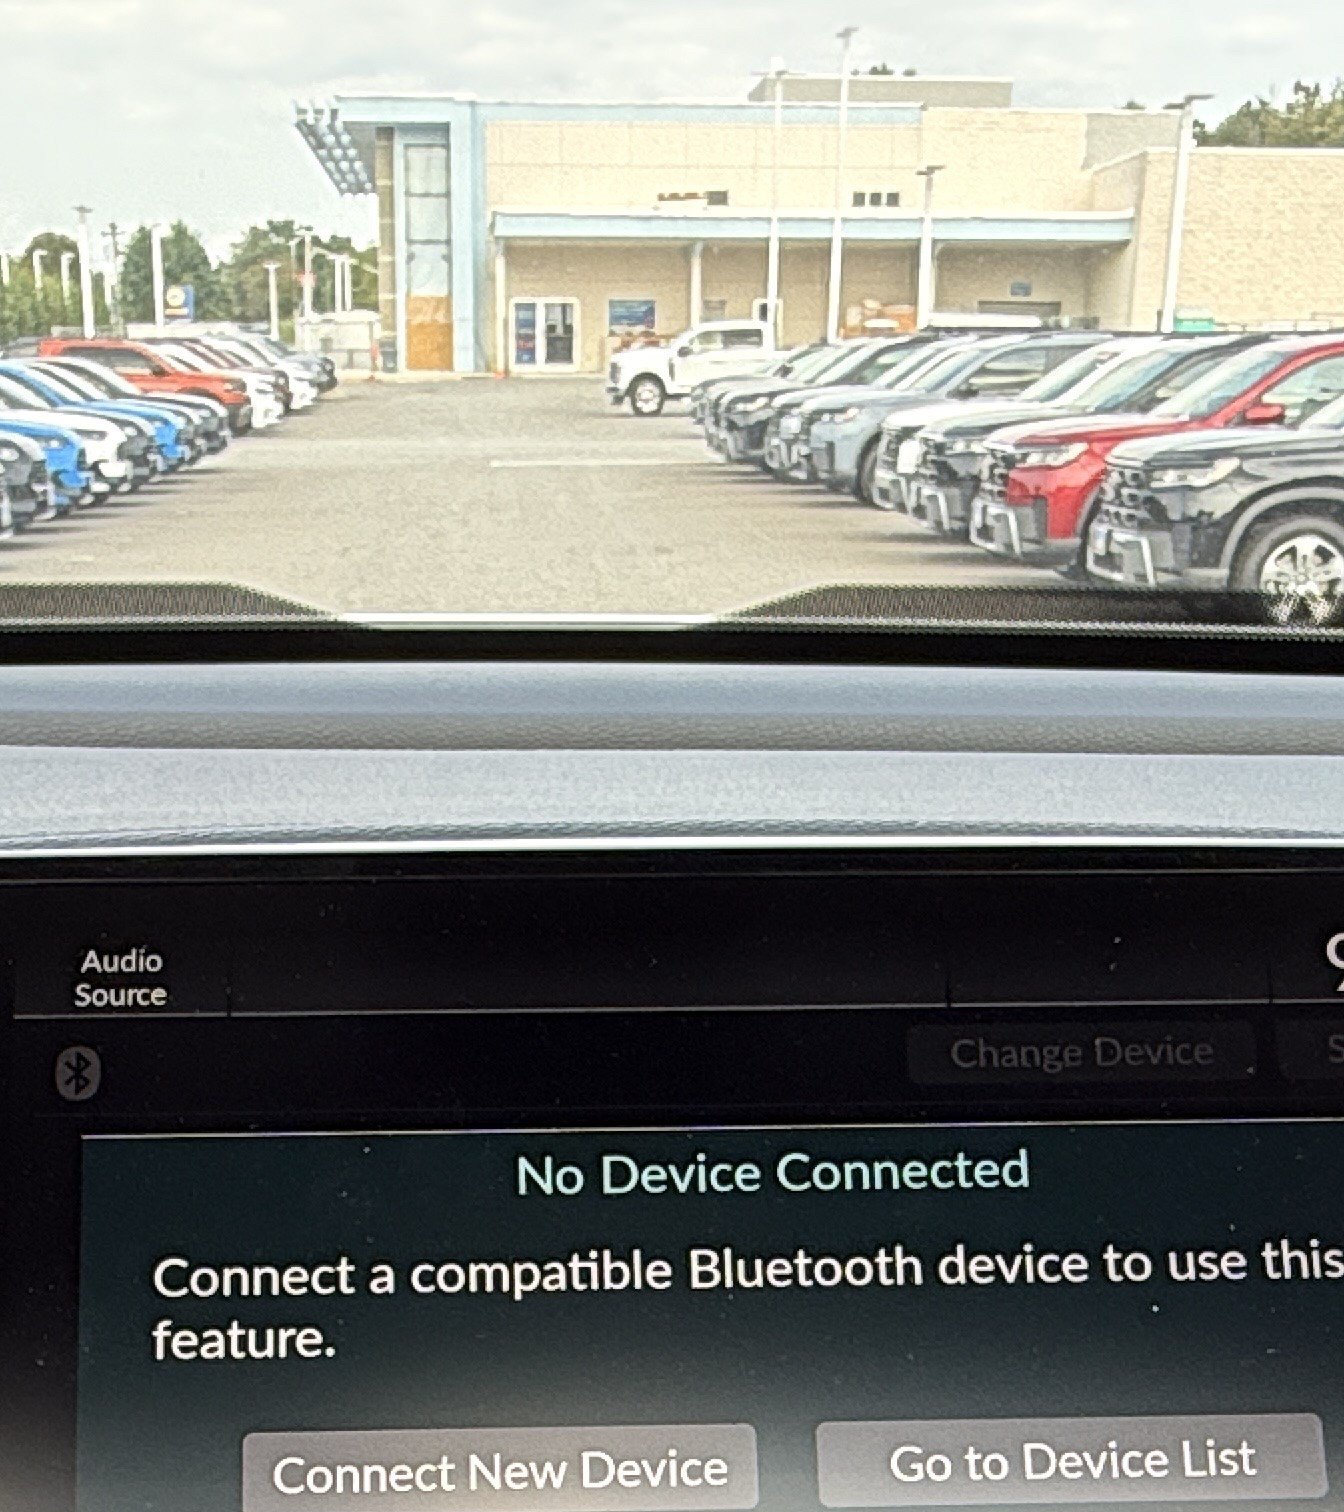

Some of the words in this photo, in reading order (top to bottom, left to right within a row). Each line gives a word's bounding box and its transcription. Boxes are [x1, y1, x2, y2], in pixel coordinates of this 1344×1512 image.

[81, 948, 162, 973] Audio
[75, 983, 167, 1007] Source
[951, 1037, 1082, 1073] Change
[1095, 1035, 1213, 1066] Device
[519, 1157, 583, 1195] No
[603, 1153, 761, 1193] Device
[777, 1149, 1029, 1191] Connected
[155, 1257, 355, 1297] Connect
[370, 1265, 394, 1293] a
[411, 1249, 671, 1300] compatible
[691, 1246, 923, 1289] Bluetooth
[939, 1243, 1088, 1284] device
[1103, 1245, 1151, 1281] to
[1169, 1251, 1247, 1281] use
[1261, 1239, 1344, 1279] this
[153, 1320, 335, 1359] feature.
[274, 1455, 455, 1494] Connect
[470, 1453, 567, 1491] New
[582, 1449, 727, 1488] Device
[891, 1447, 951, 1481] Go
[965, 1447, 1009, 1480] to
[1023, 1441, 1169, 1479] Device
[1183, 1439, 1257, 1477] List
